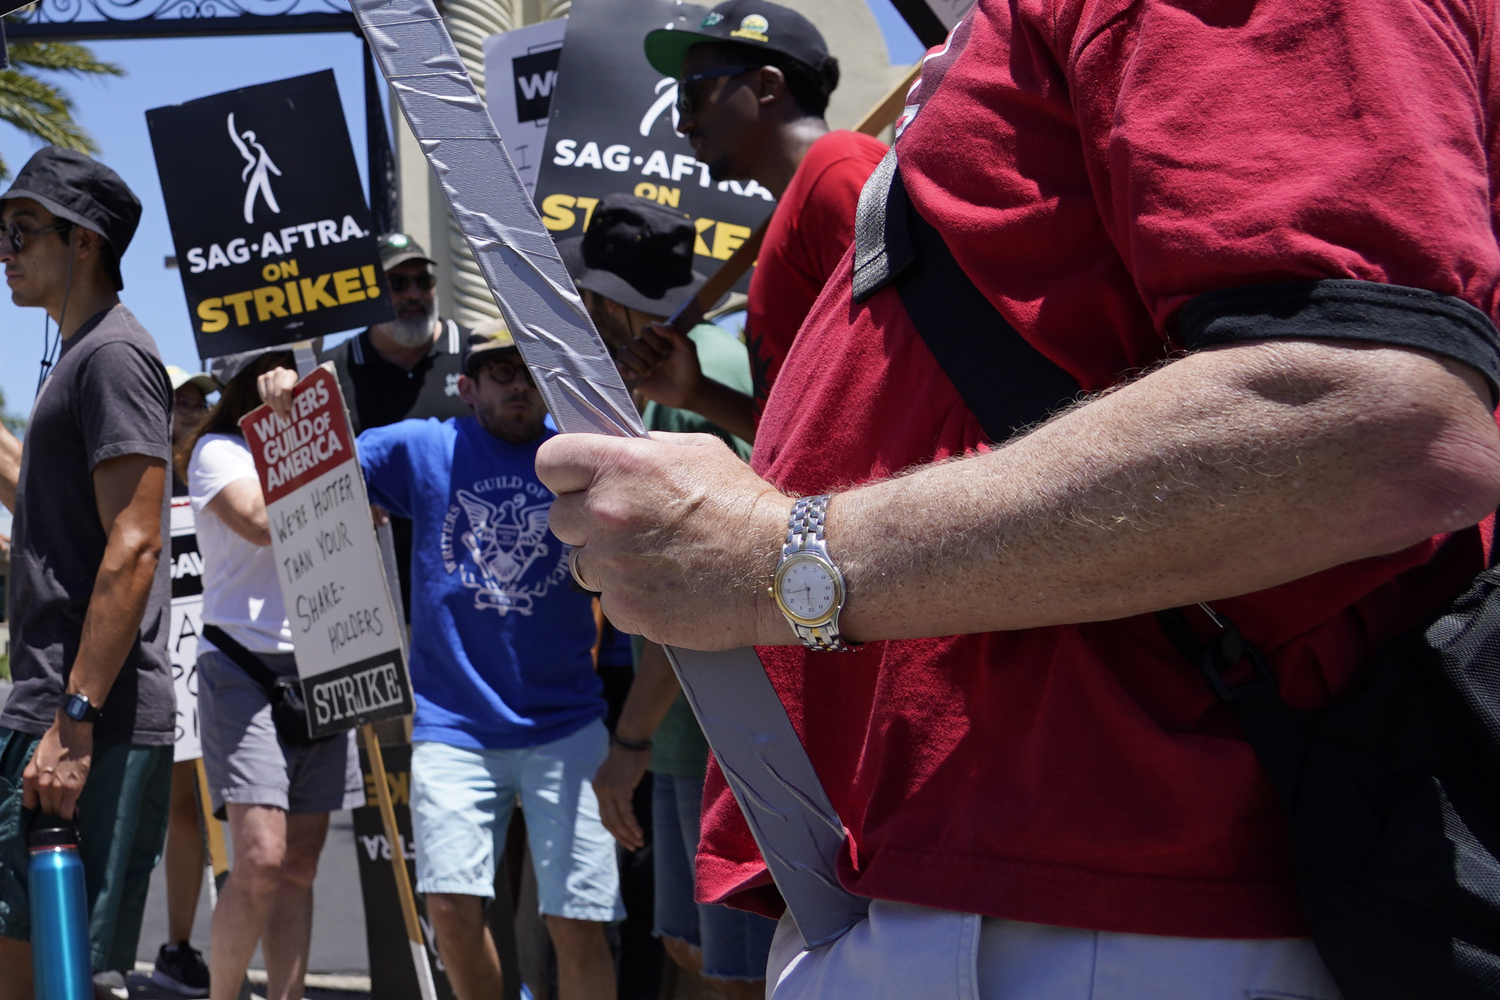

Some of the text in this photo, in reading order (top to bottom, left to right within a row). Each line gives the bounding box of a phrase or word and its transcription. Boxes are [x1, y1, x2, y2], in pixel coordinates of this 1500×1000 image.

[634, 181, 680, 208] ON
[262, 259, 299, 282] ON
[197, 264, 381, 333] STRIKE!
[263, 411, 331, 466] GUILD OF
[267, 430, 343, 492] AMERICA
[473, 476, 523, 494] GUILD
[284, 521, 353, 584] THAN YOUR
[327, 607, 383, 654] HOLDERS
[312, 662, 403, 726] STRIKE
